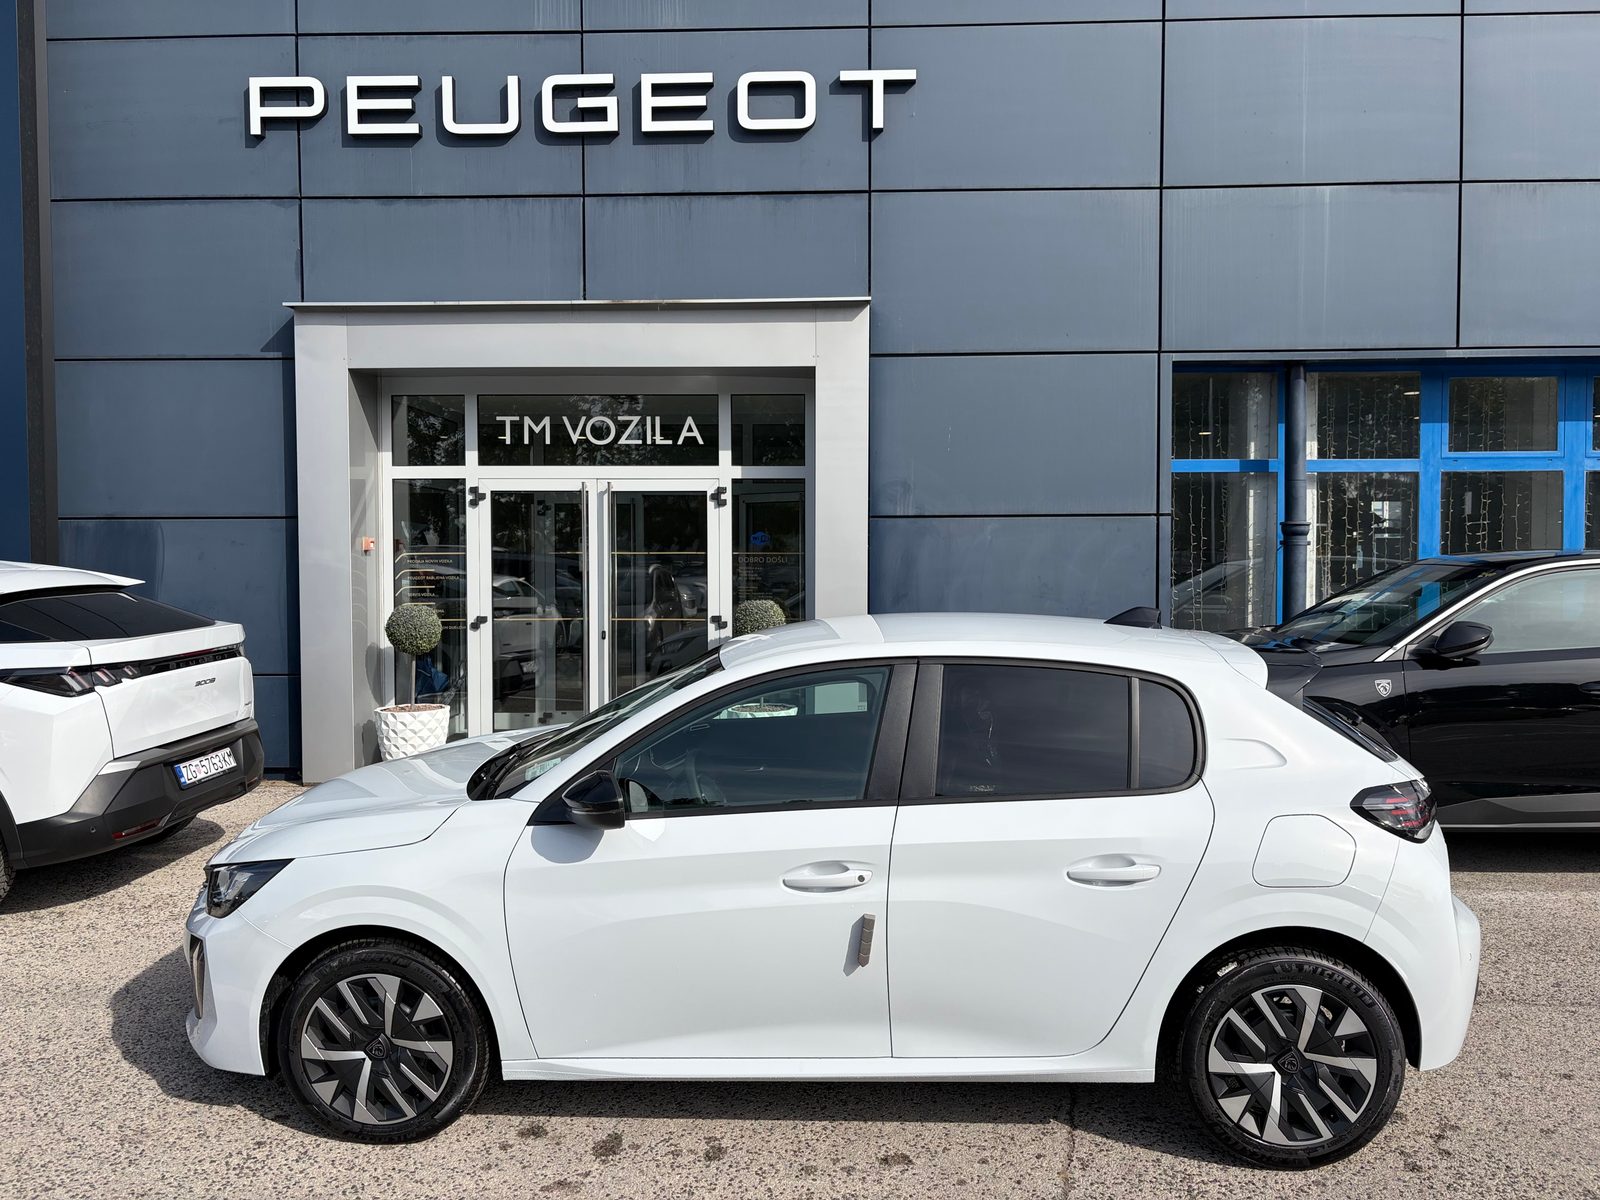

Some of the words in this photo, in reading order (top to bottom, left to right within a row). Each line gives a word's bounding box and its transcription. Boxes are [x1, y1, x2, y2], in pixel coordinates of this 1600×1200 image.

[248, 69, 917, 136] PEUGEOT
[496, 416, 551, 445] TM
[562, 416, 704, 446] VOZILA
[182, 763, 198, 781] ZG
[1303, 963, 1376, 1009] MICHELIN
